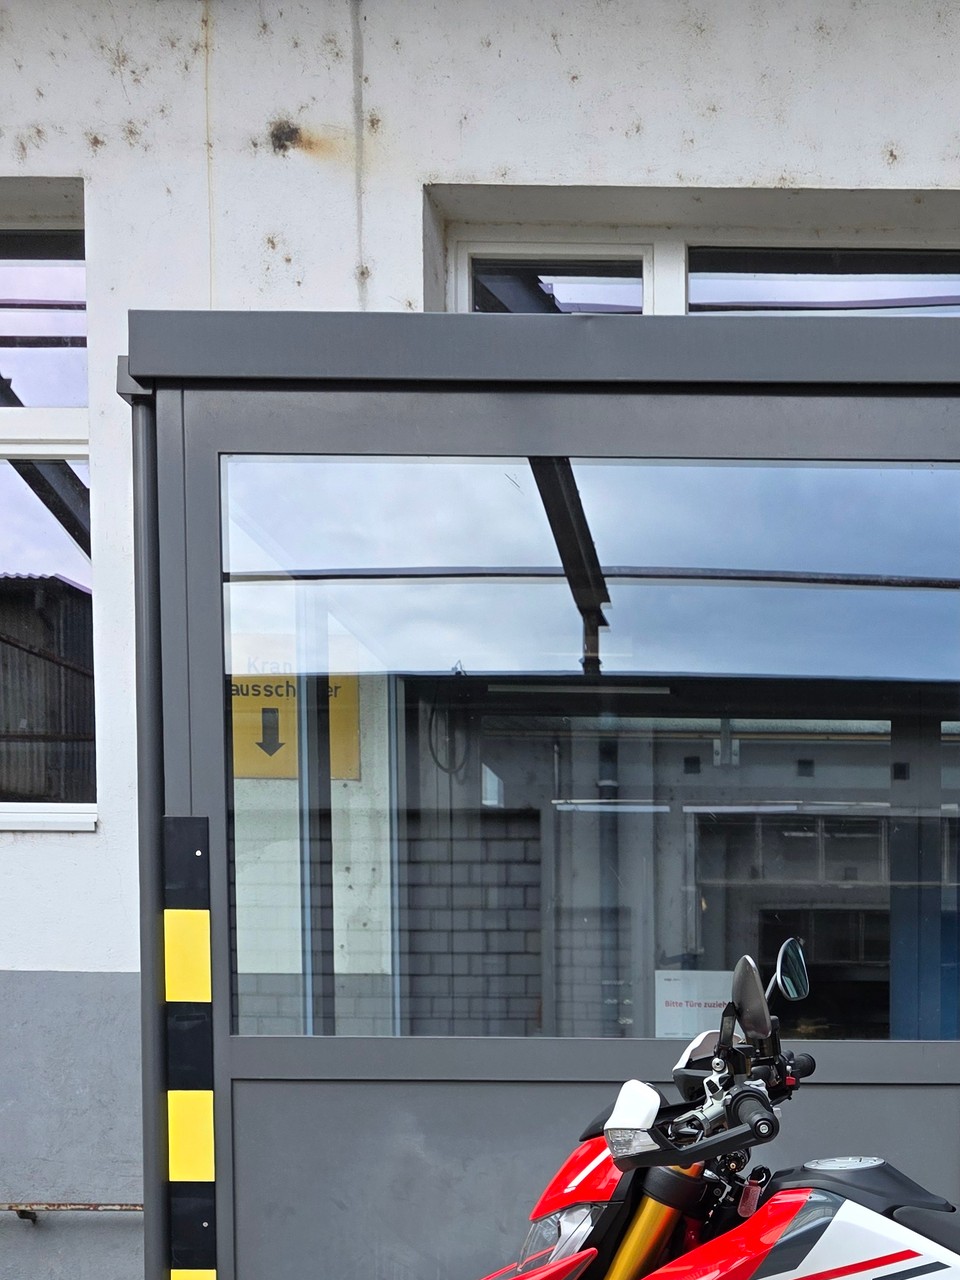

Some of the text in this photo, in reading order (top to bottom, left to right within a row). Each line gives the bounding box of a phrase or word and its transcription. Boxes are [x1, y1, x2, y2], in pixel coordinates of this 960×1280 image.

[665, 1000, 727, 1009] Bitte Türe zuzieh
